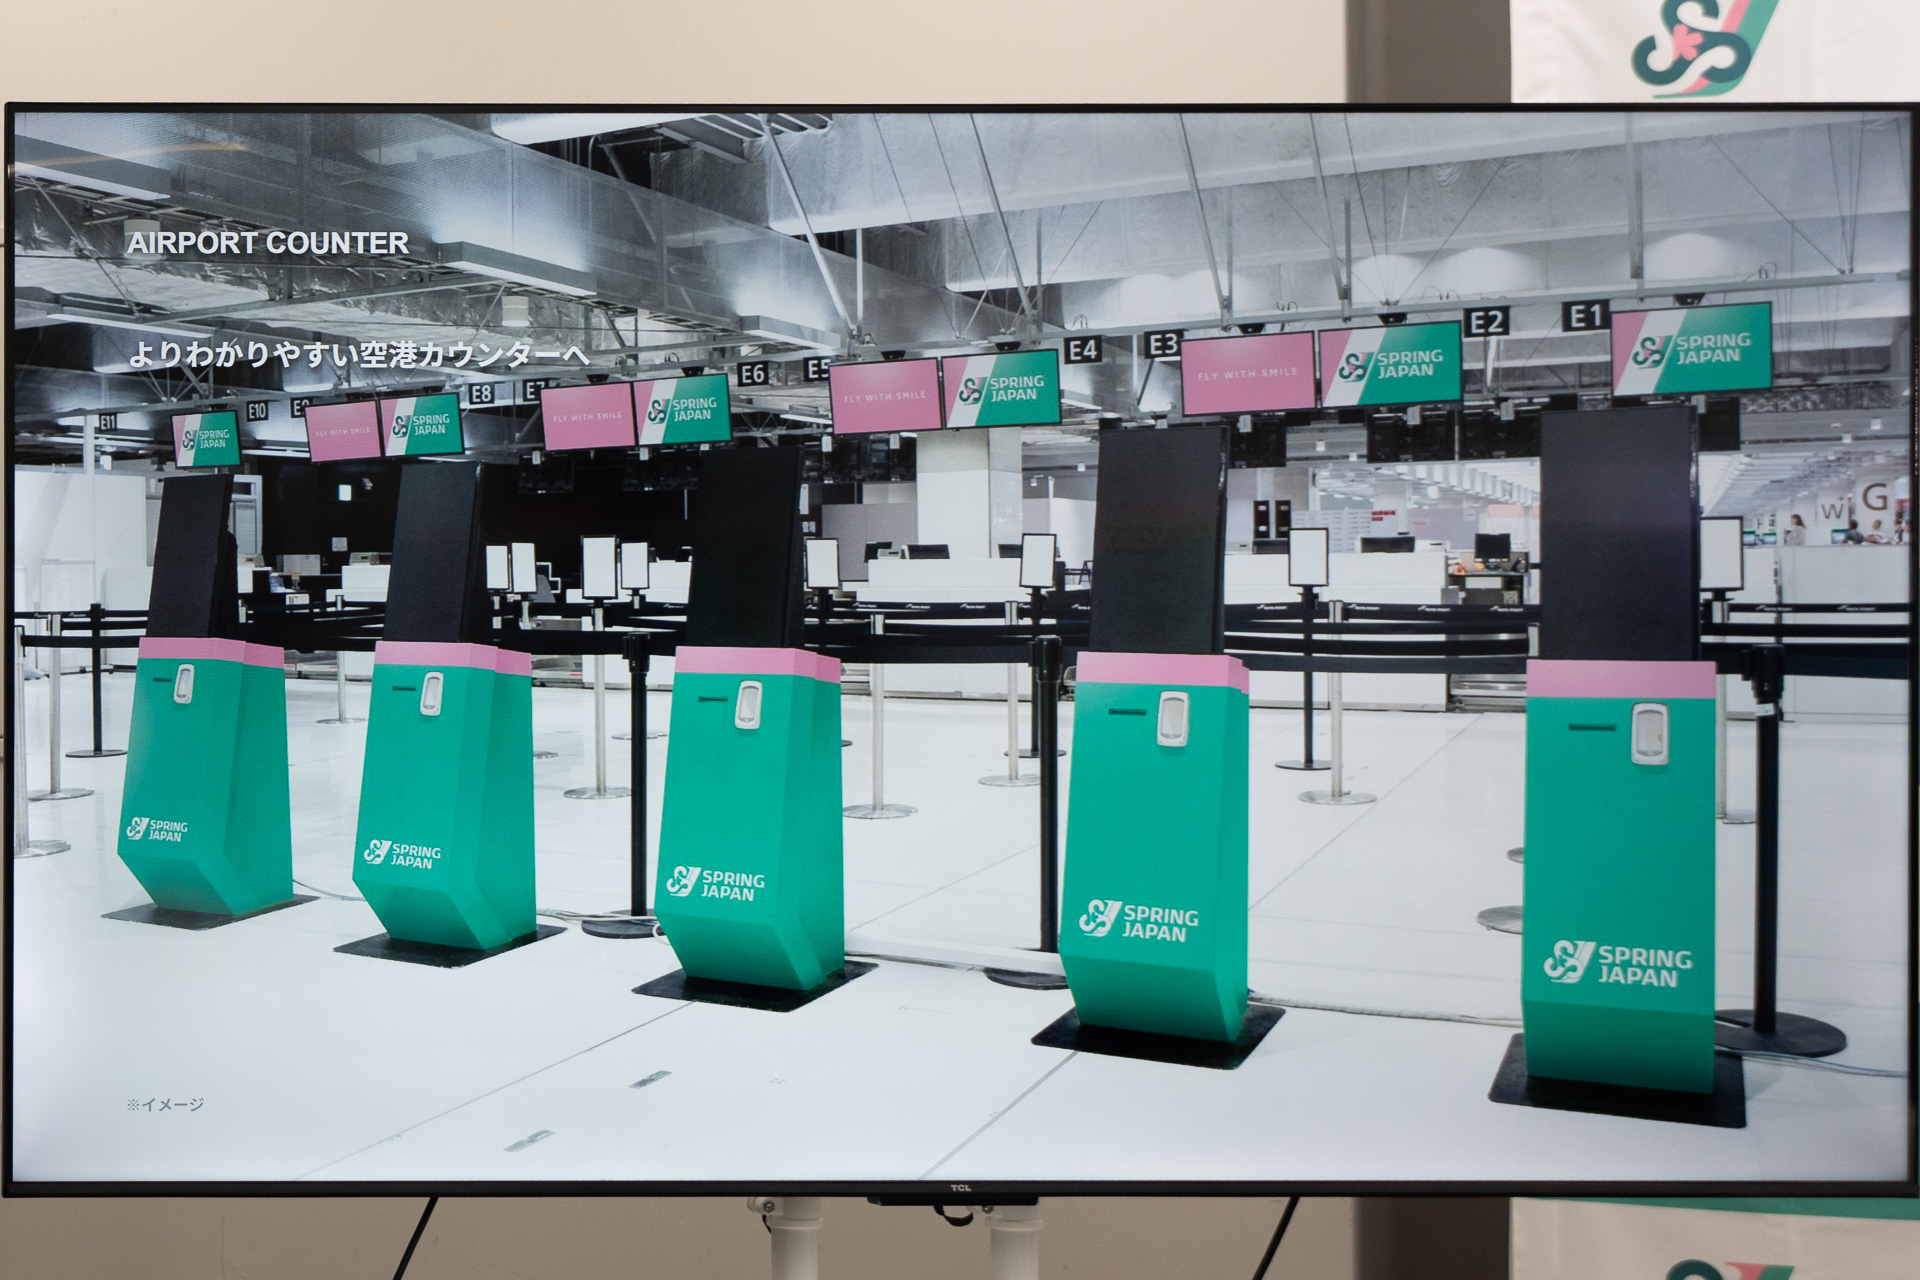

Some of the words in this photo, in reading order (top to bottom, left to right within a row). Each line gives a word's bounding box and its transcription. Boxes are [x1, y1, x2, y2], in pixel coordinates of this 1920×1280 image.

[127, 231, 258, 254] AIRPORT
[266, 231, 409, 254] COUNTER
[1470, 310, 1503, 334] E2
[1570, 304, 1601, 328] E1
[1150, 333, 1178, 355] E3
[1675, 332, 1752, 351] SPRING
[128, 340, 591, 369] よりわかりやすい空港カウンターへ
[1069, 340, 1098, 361] E4
[1376, 349, 1444, 366] SPRING
[1676, 348, 1740, 366] JAPAN
[741, 364, 765, 384] E6
[808, 358, 831, 379] E5
[1197, 372, 1219, 381] FLY
[1223, 369, 1256, 380] WITH
[1261, 367, 1298, 377] SMILE
[1377, 364, 1435, 379] JAPAN
[989, 374, 1045, 389] SPRING
[472, 384, 492, 402] E8
[844, 395, 861, 403] FLY
[865, 392, 892, 402] WITH
[896, 390, 927, 400] SMILE
[990, 387, 1037, 403] JAPAN
[249, 402, 266, 419] E10
[672, 396, 717, 410] SPRING
[100, 415, 116, 430] E11
[412, 413, 450, 426] SPRING
[553, 414, 568, 423] FLY
[571, 412, 594, 422] WITH
[597, 411, 622, 420] SMILE
[673, 409, 712, 422] JAPAN
[199, 429, 230, 440] SPRING
[414, 424, 446, 436] JAPAN
[200, 439, 226, 449] JAPAN
[1862, 482, 1888, 511] G
[150, 819, 188, 833] SPRING
[148, 830, 182, 842] JAPAN
[391, 843, 441, 859] SPRING
[390, 855, 433, 870] JAPAN
[702, 870, 765, 888] SPRING
[700, 884, 755, 902] JAPAN
[1123, 904, 1199, 927] SPRING
[1122, 921, 1186, 943] JAPAN
[1598, 945, 1693, 969] SPRING
[1598, 965, 1678, 988] JAPAN
[127, 1097, 204, 1112] ※イメージ
